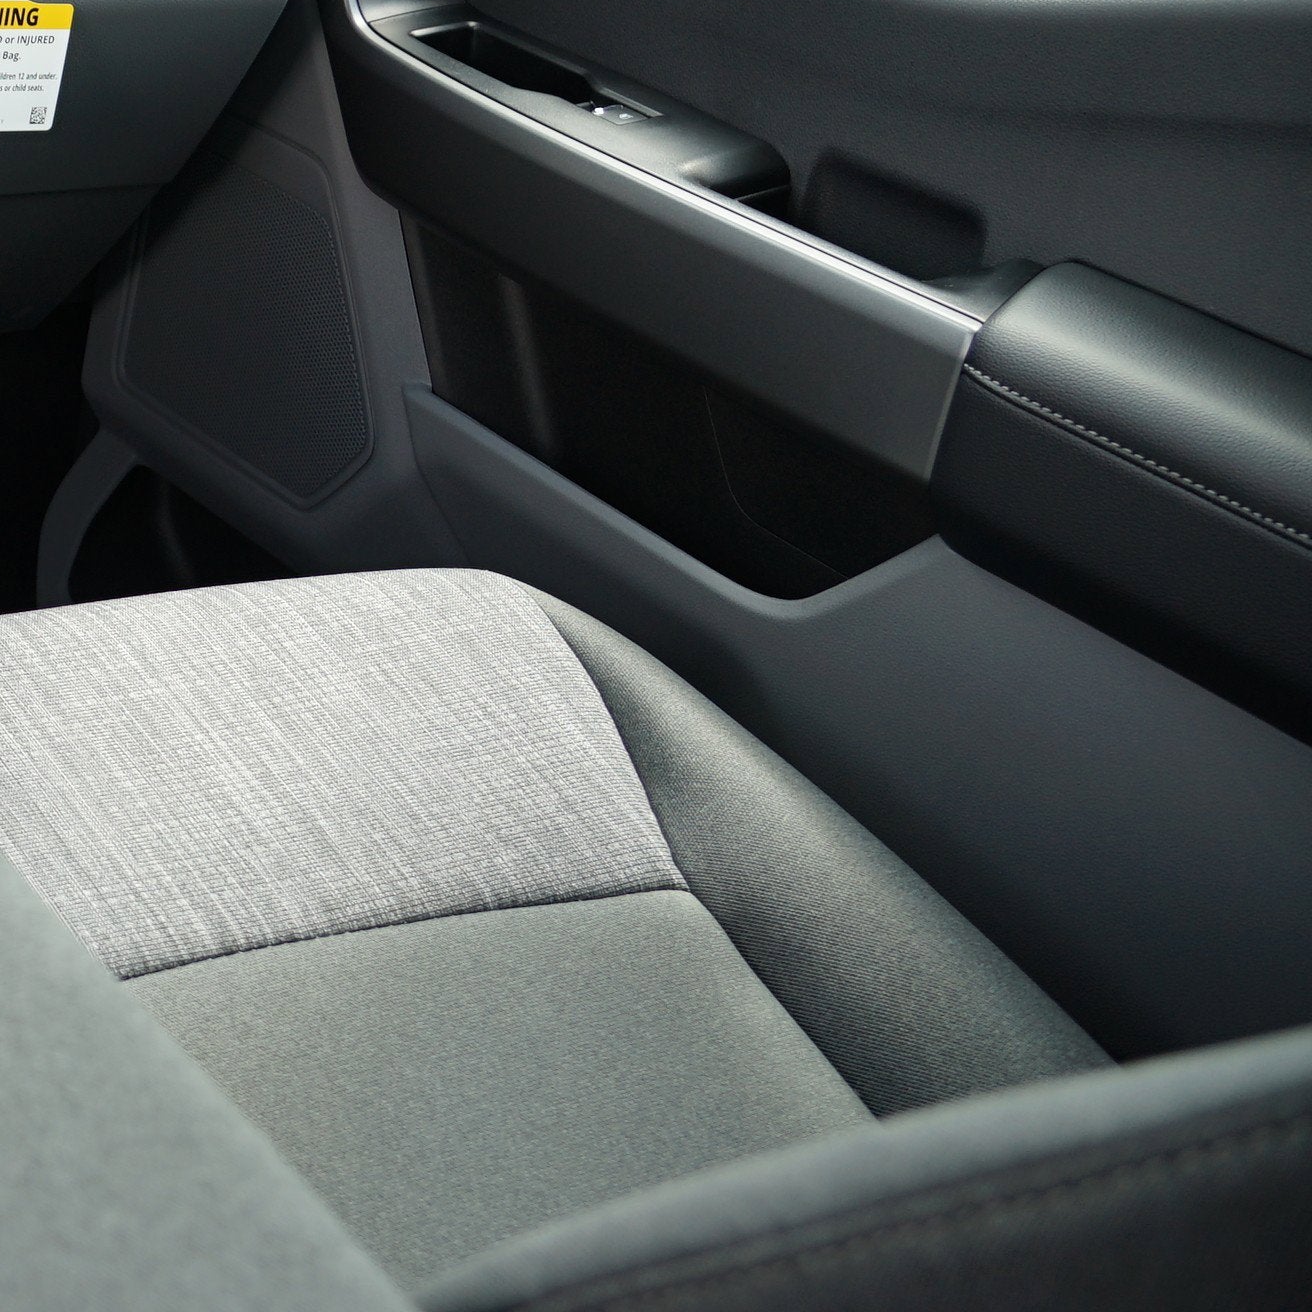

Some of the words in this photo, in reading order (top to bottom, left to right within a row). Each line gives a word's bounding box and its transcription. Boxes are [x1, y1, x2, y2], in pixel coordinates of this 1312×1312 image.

[5, 36, 16, 44] or
[17, 35, 55, 46] INJURED
[2, 51, 22, 62] Bag.
[18, 72, 25, 80] 12
[26, 72, 38, 80] and
[12, 83, 26, 92] child
[27, 84, 44, 92] seats.
